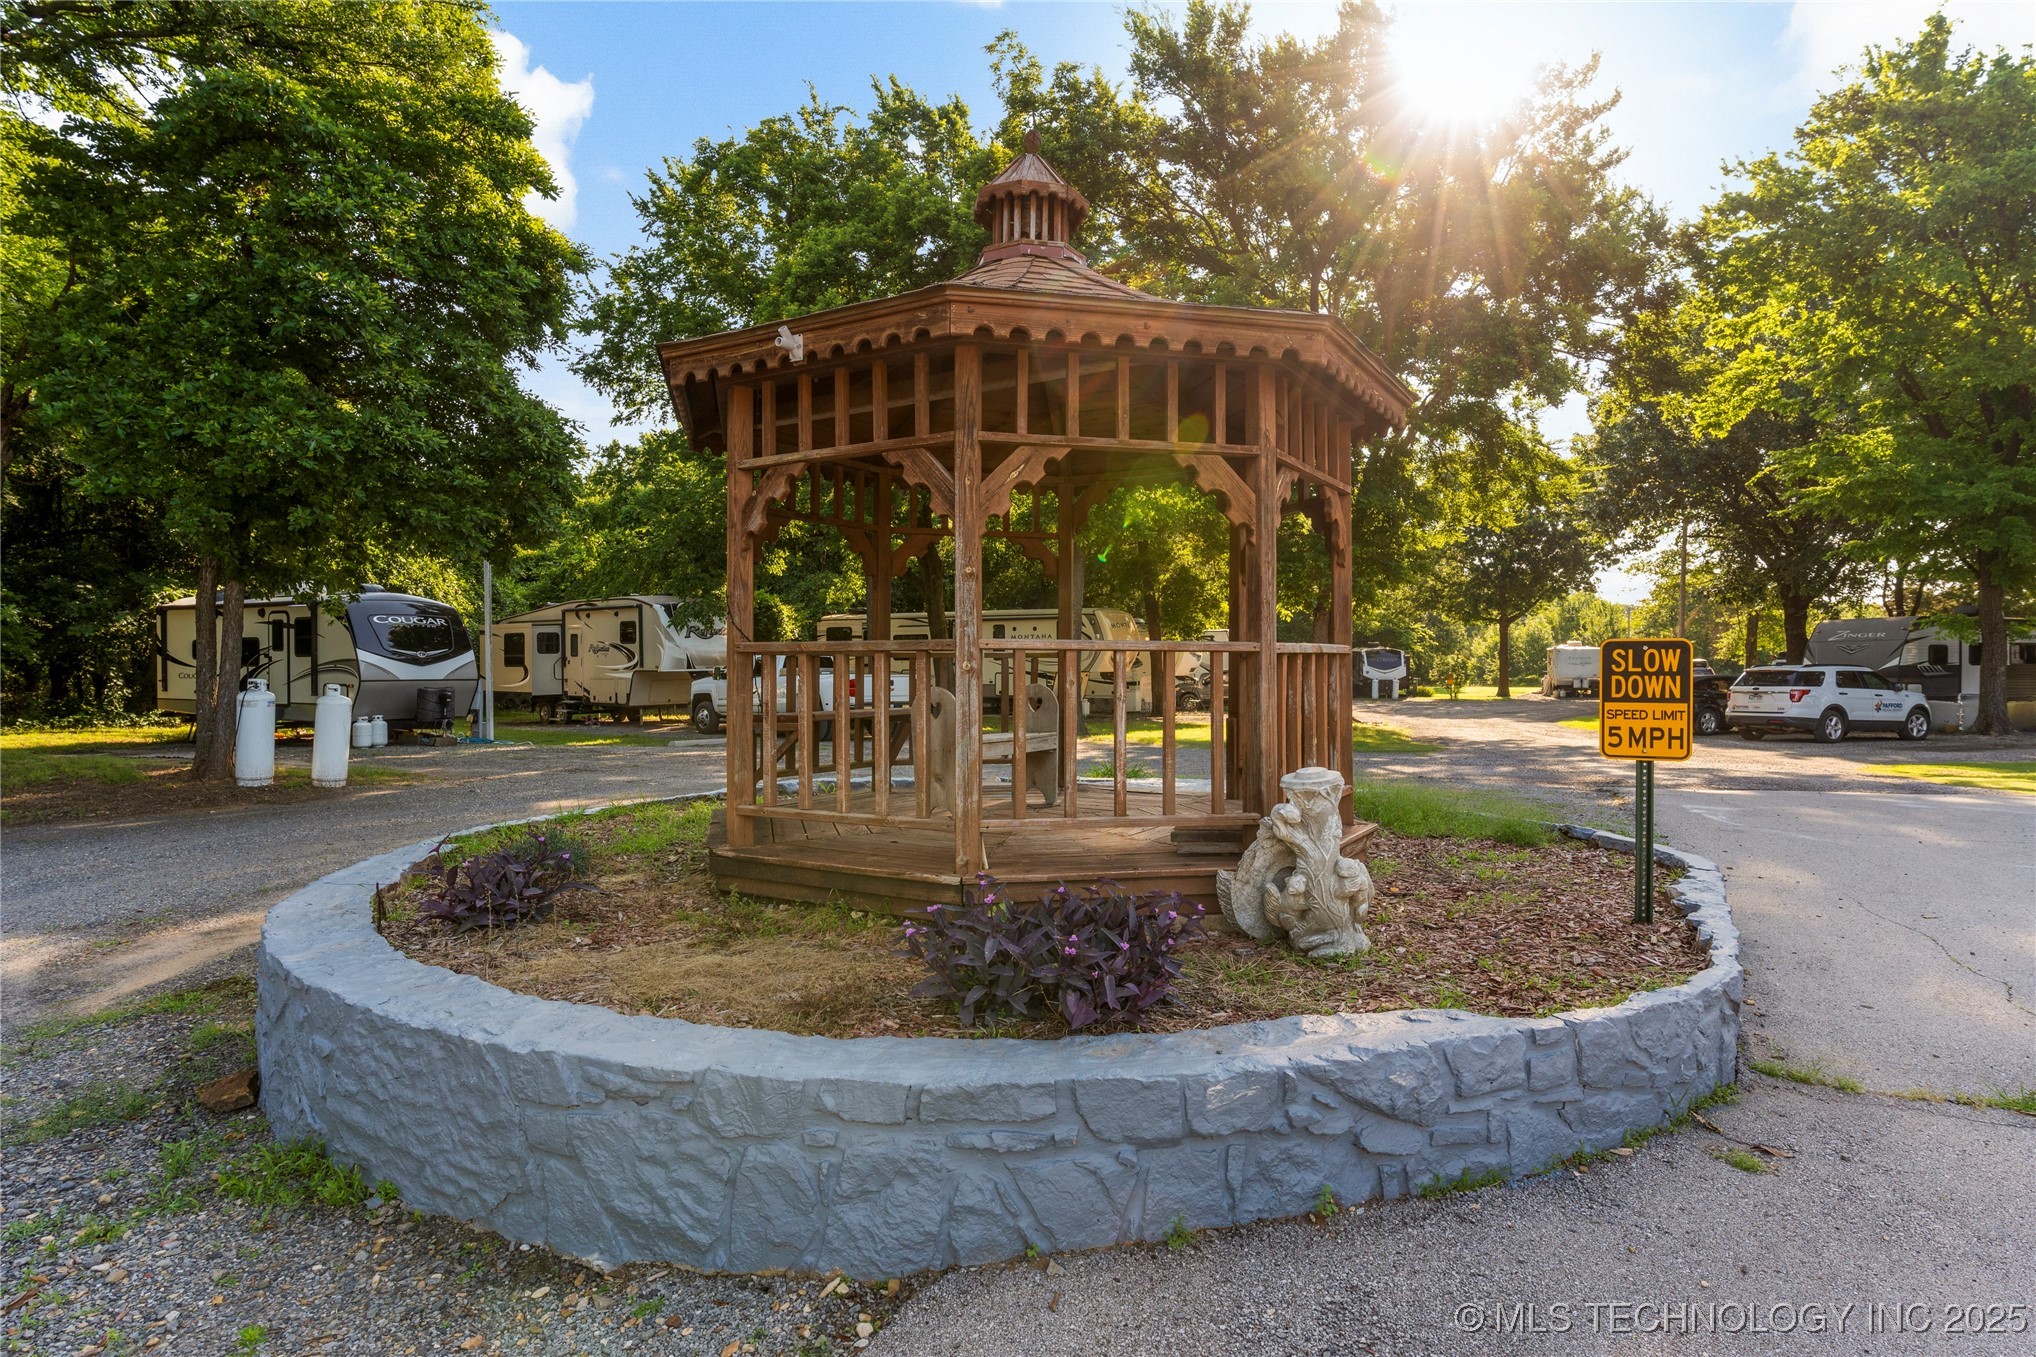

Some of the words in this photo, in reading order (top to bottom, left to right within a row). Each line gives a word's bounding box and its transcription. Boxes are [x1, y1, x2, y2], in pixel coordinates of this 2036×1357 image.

[373, 615, 448, 626] COUGAR
[1827, 630, 1886, 642] ZINGER
[1611, 648, 1681, 672] SLOW
[1611, 675, 1681, 699] DOWN
[1606, 709, 1648, 720] SPEED
[1652, 710, 1686, 721] LIMIT
[1608, 726, 1623, 748] 5
[1628, 726, 1684, 750] MPH
